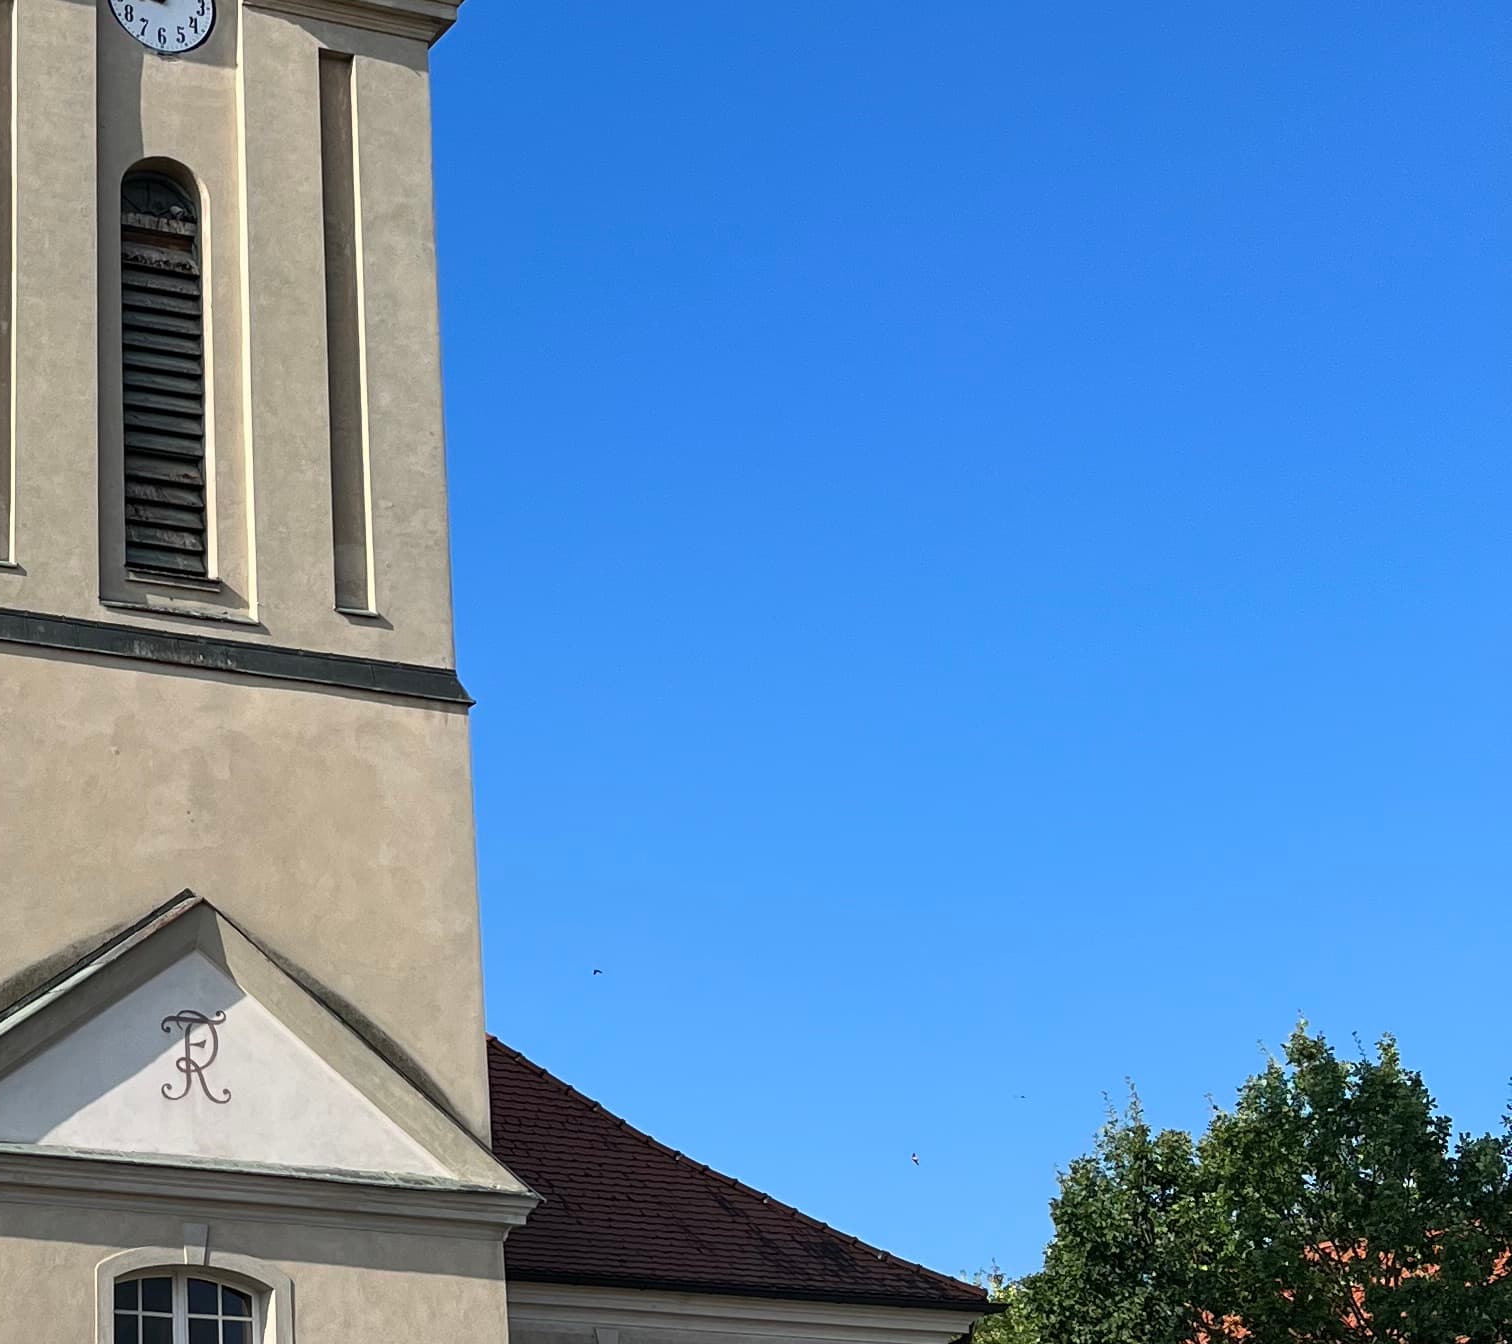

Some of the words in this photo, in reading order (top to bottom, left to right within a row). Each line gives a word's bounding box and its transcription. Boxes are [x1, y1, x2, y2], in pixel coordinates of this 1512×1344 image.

[124, 5, 134, 22] 8
[197, 0, 205, 16] 3
[140, 18, 148, 36] 7
[188, 16, 198, 34] 4
[158, 27, 166, 44] 6
[176, 26, 185, 43] 5
